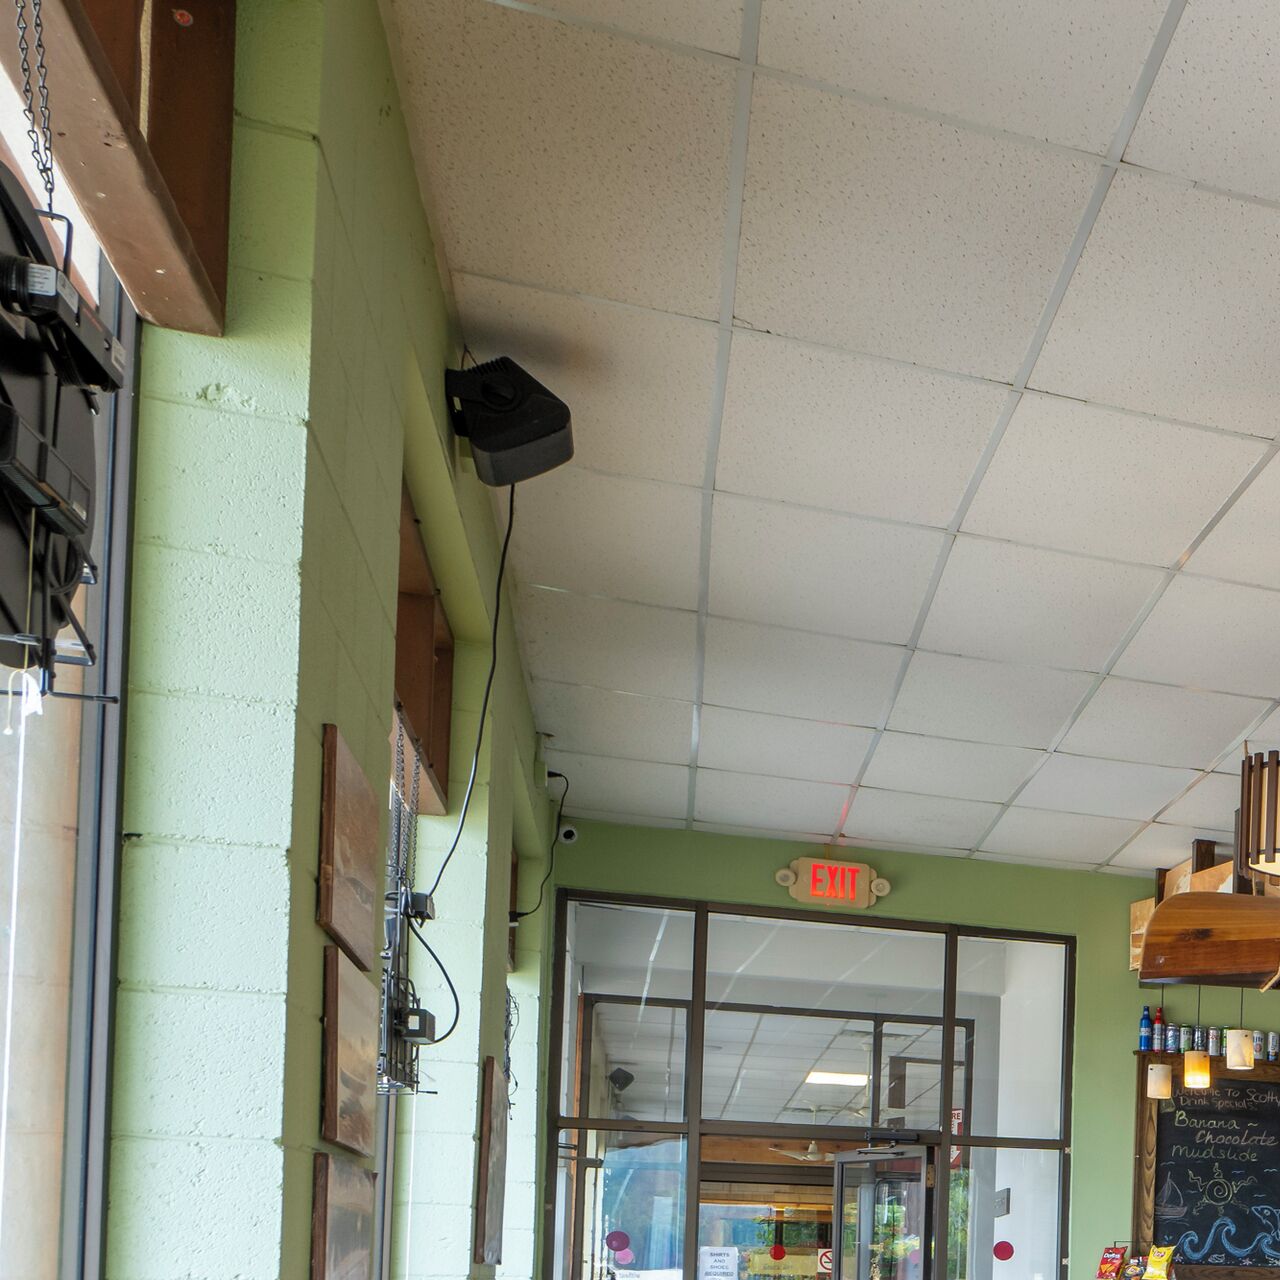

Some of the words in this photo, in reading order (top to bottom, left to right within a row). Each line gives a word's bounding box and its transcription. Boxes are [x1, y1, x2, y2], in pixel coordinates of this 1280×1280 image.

[810, 863, 861, 902] EXIT
[1174, 1110, 1241, 1130] Banana
[1194, 1129, 1280, 1147] Chocolate
